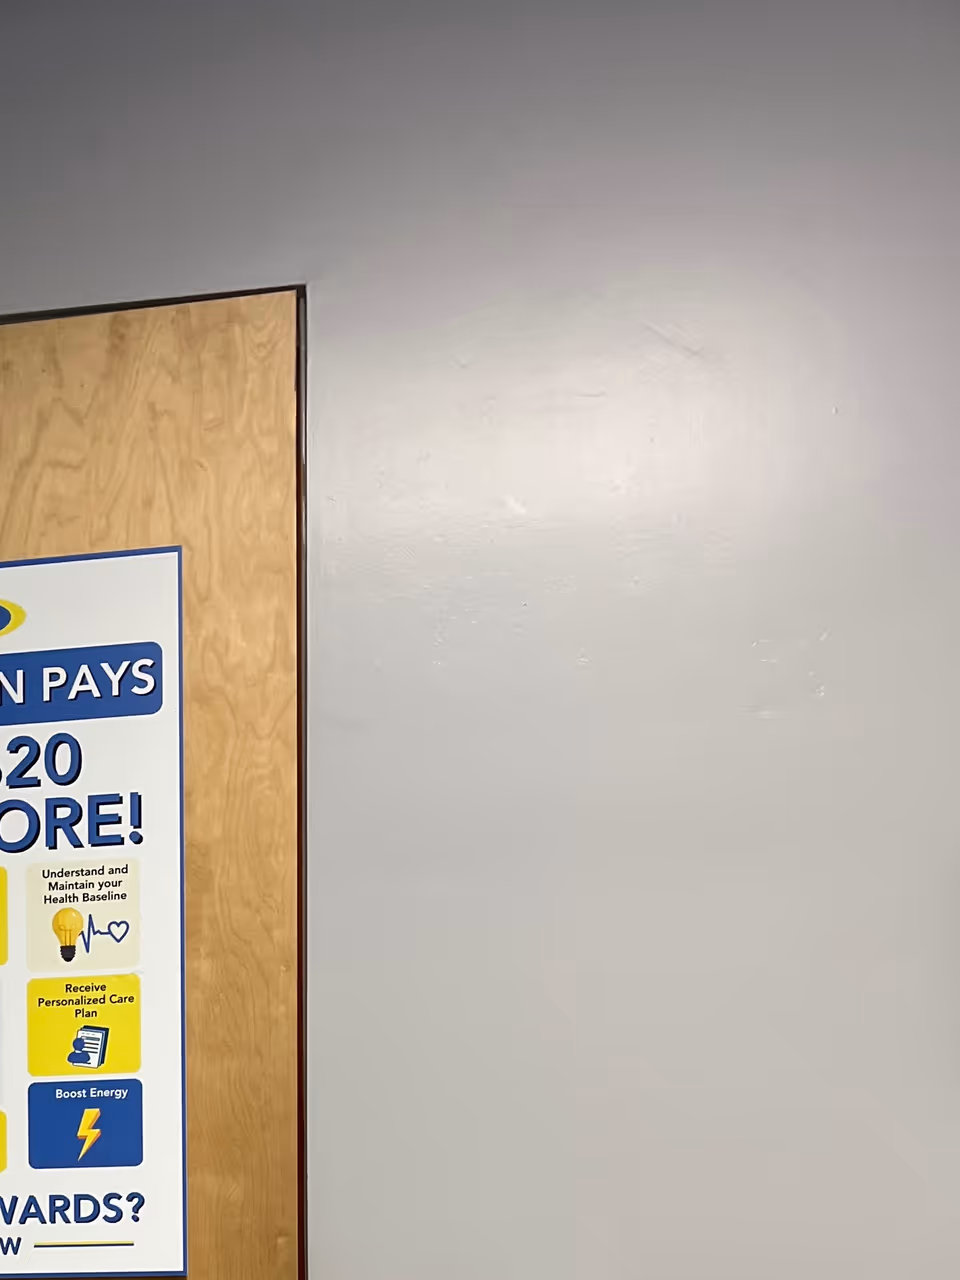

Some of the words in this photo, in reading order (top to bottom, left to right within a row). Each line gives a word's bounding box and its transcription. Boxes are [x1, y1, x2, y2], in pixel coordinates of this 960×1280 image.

[42, 658, 156, 702] PAYS
[42, 866, 104, 879] Understand
[107, 865, 129, 876] and
[48, 880, 94, 891] Maintain
[98, 880, 122, 891] your
[44, 893, 79, 904] Health
[82, 890, 127, 901] Baseline
[65, 982, 107, 994] Receive
[38, 994, 105, 1007] Personalized
[109, 993, 135, 1005] Care
[74, 1007, 98, 1019] Plan
[56, 1087, 86, 1099] Boost
[89, 1086, 128, 1100] Energy
